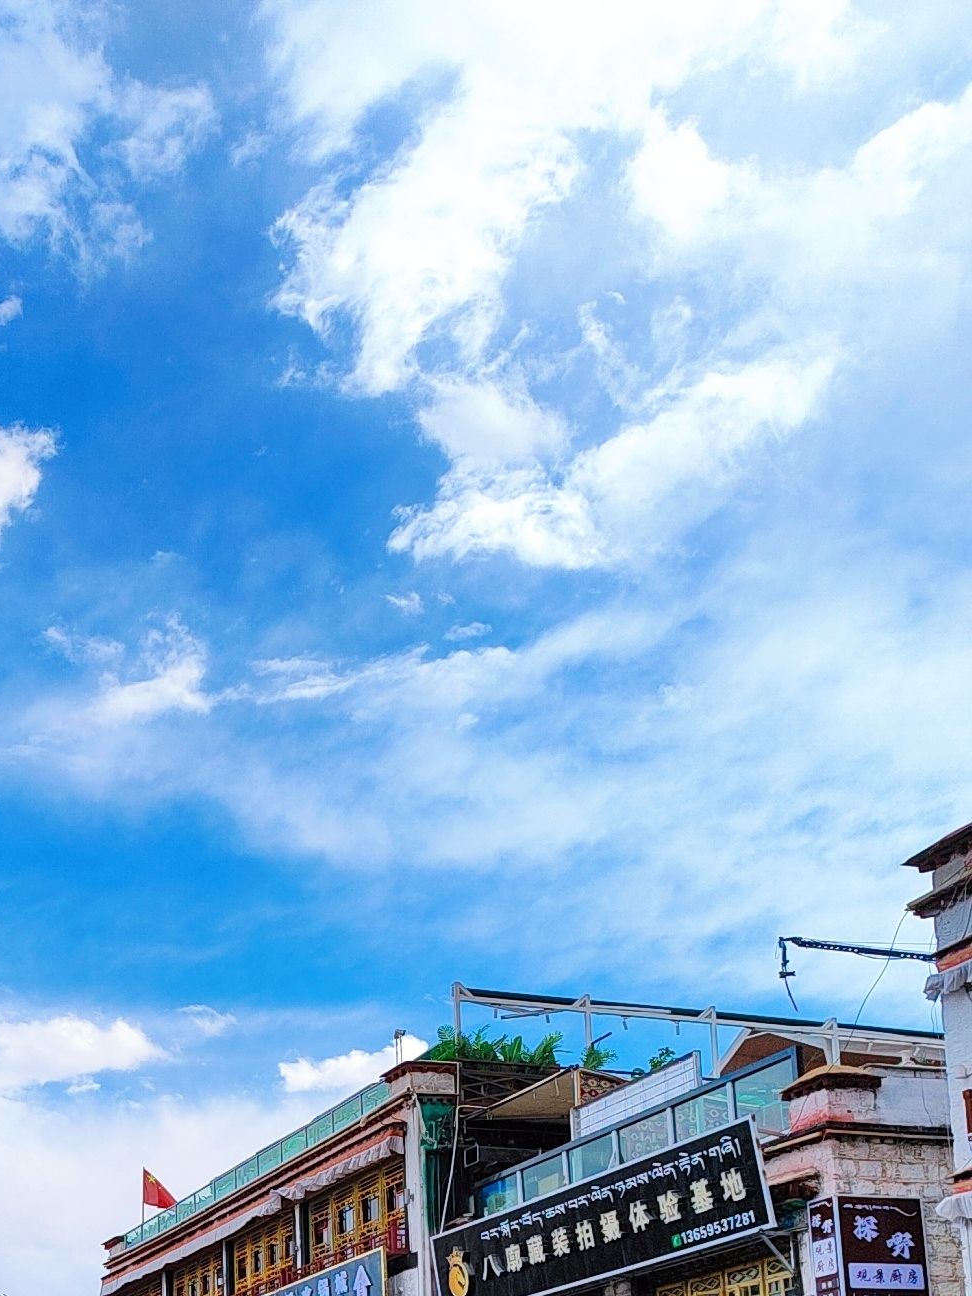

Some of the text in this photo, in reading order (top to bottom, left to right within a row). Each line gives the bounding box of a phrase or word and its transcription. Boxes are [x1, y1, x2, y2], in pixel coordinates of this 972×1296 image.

[481, 1166, 748, 1282] 八廓藏装拍摄体验基地
[681, 1209, 757, 1245] 13659537281
[856, 1268, 919, 1286] 观景厨房
